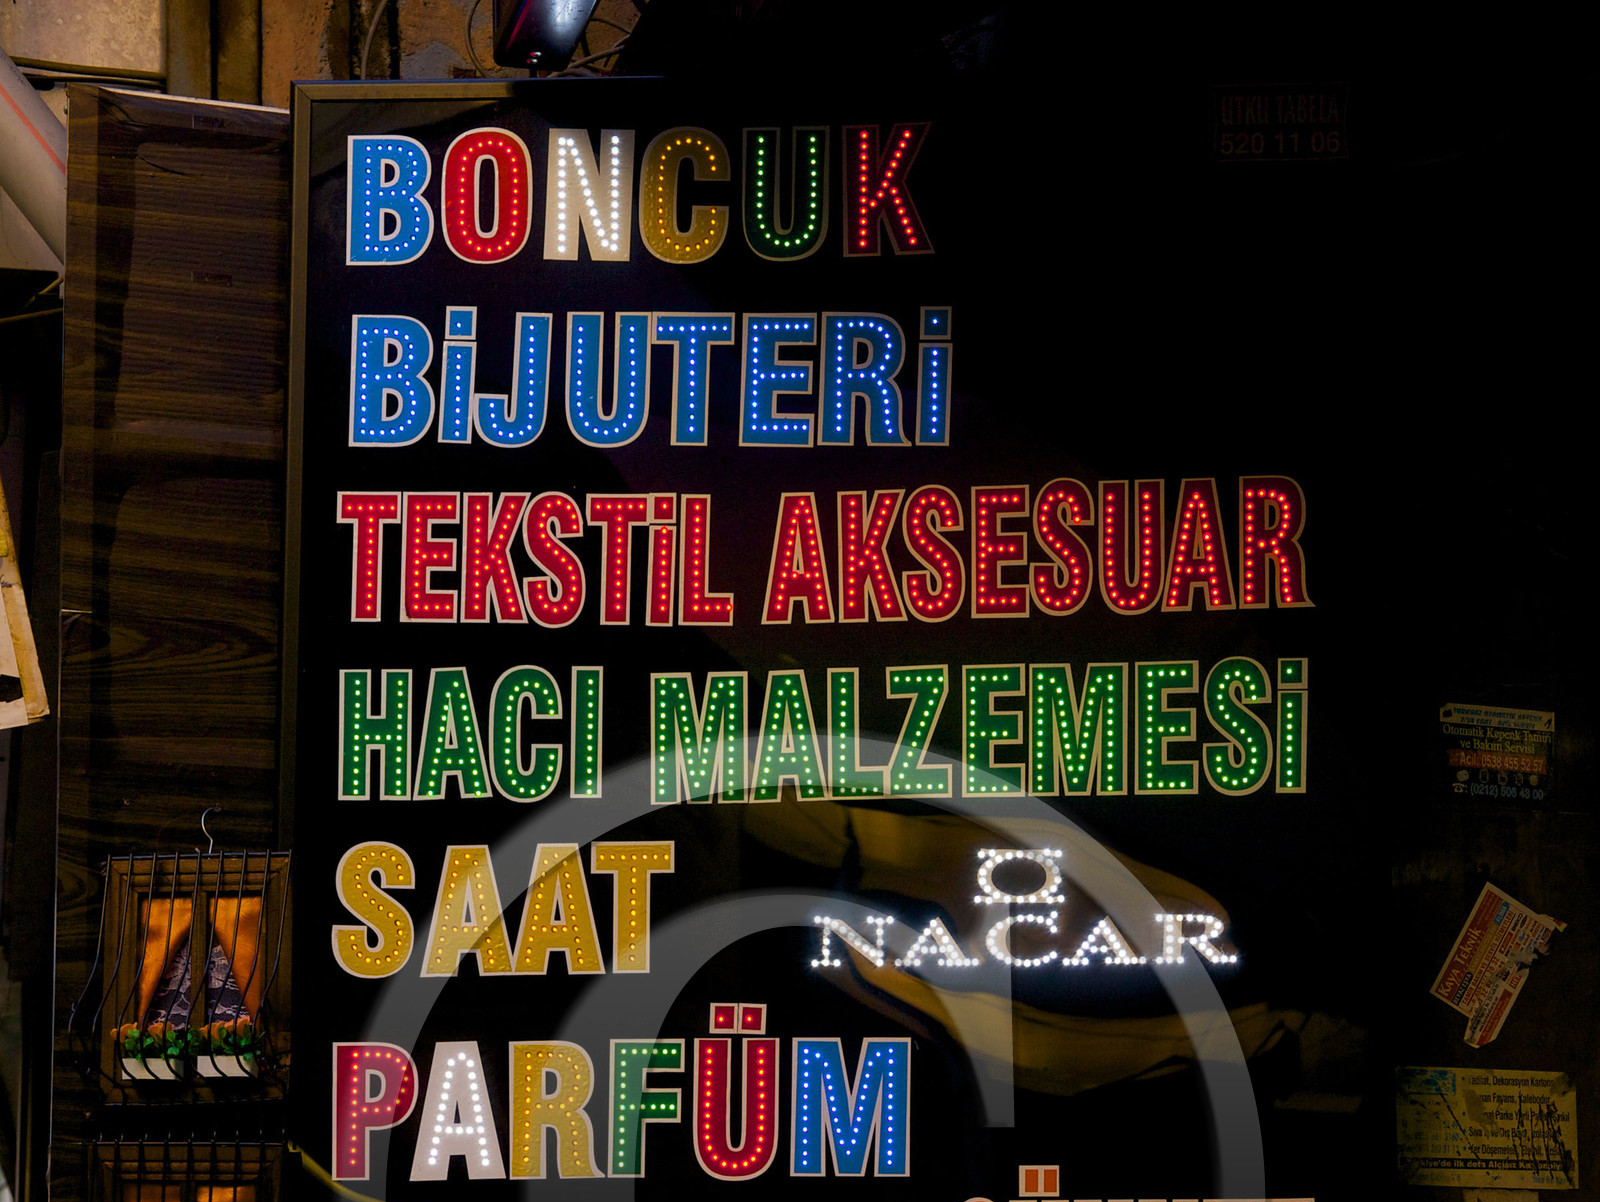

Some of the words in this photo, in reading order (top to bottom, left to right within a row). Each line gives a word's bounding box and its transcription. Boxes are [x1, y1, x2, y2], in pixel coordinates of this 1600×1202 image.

[346, 121, 935, 266] BONCUK
[1219, 131, 1265, 155] 520
[1310, 130, 1341, 154] 06
[761, 475, 1315, 626] AKSESUAR
[337, 665, 604, 803] HACI
[331, 840, 675, 979] SAAT
[810, 911, 1239, 969] NACAR
[331, 1002, 912, 1182] PARFÜM
